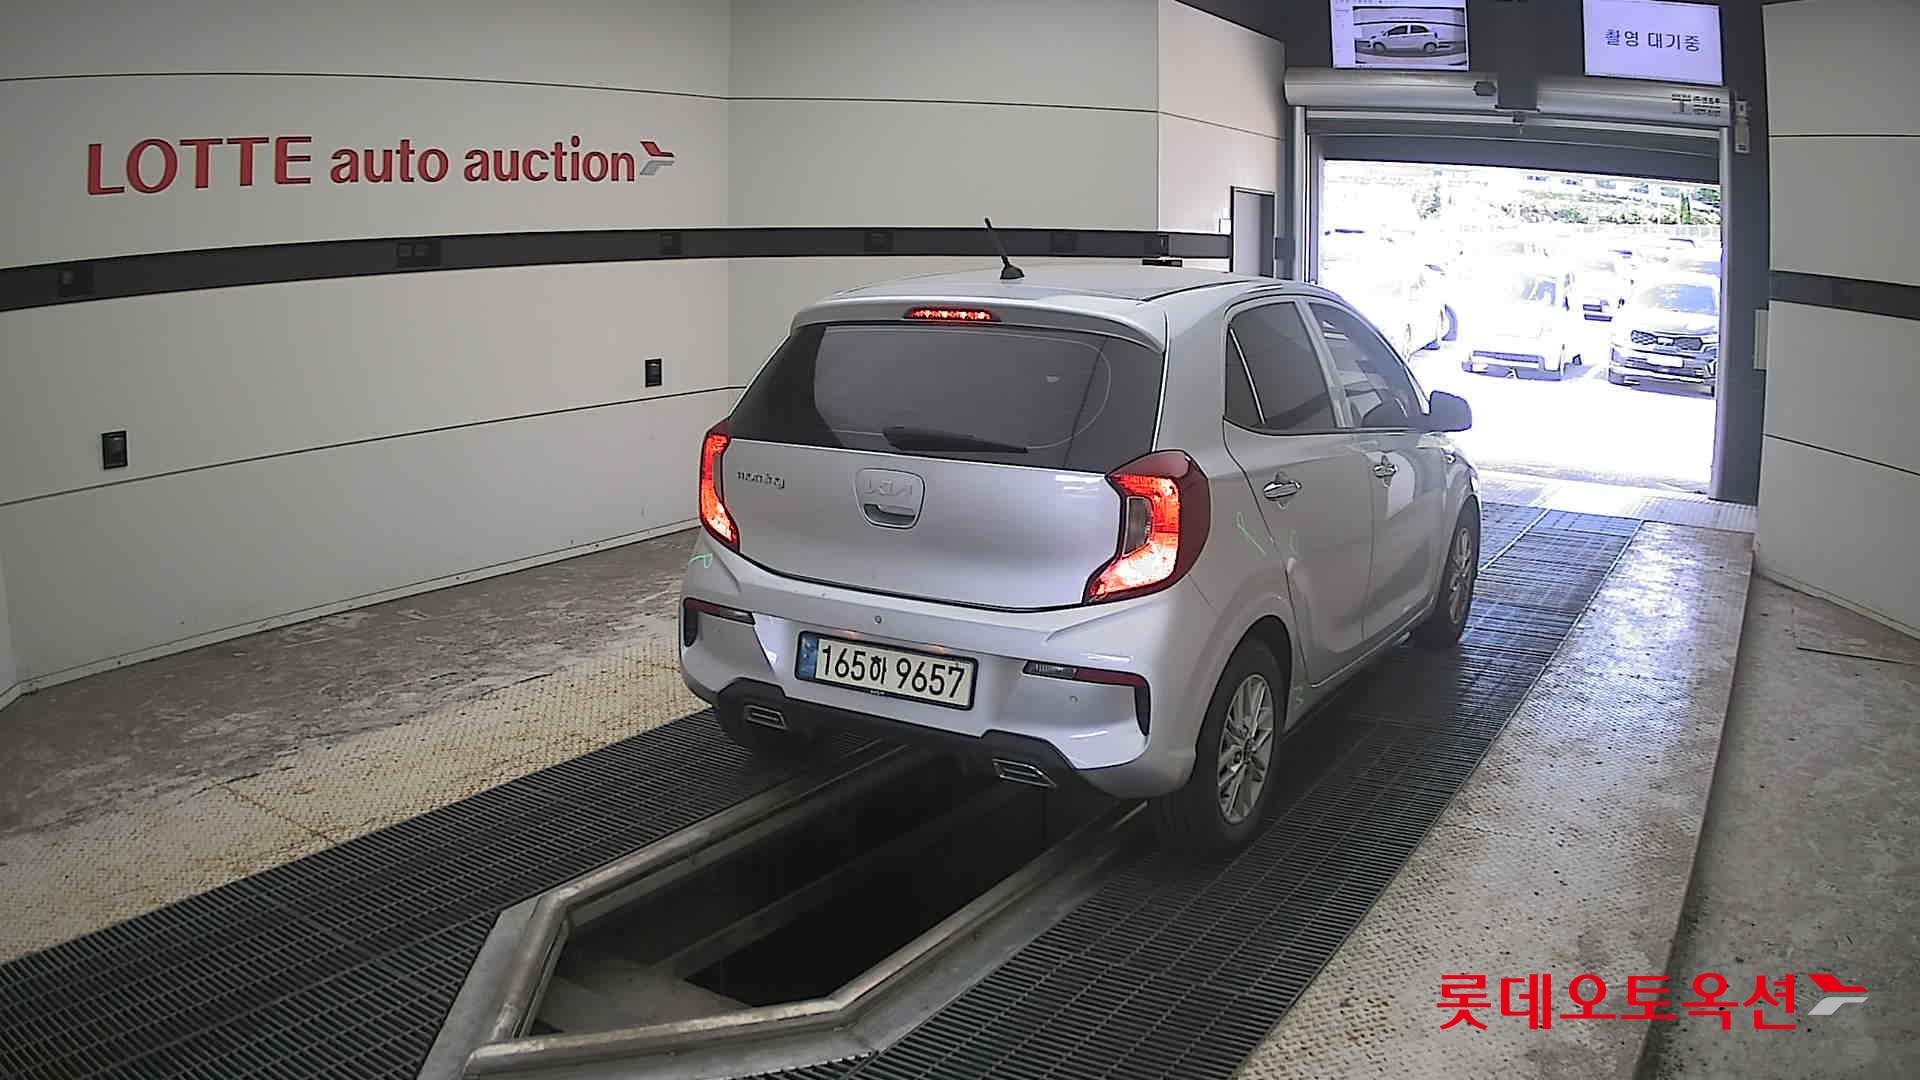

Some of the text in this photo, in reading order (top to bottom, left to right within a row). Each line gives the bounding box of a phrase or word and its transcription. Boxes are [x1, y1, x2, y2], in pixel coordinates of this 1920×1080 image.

[1647, 32, 1700, 52] 대기중
[88, 136, 636, 195] LOTTE auto auction
[822, 644, 965, 698] 165하 9657
